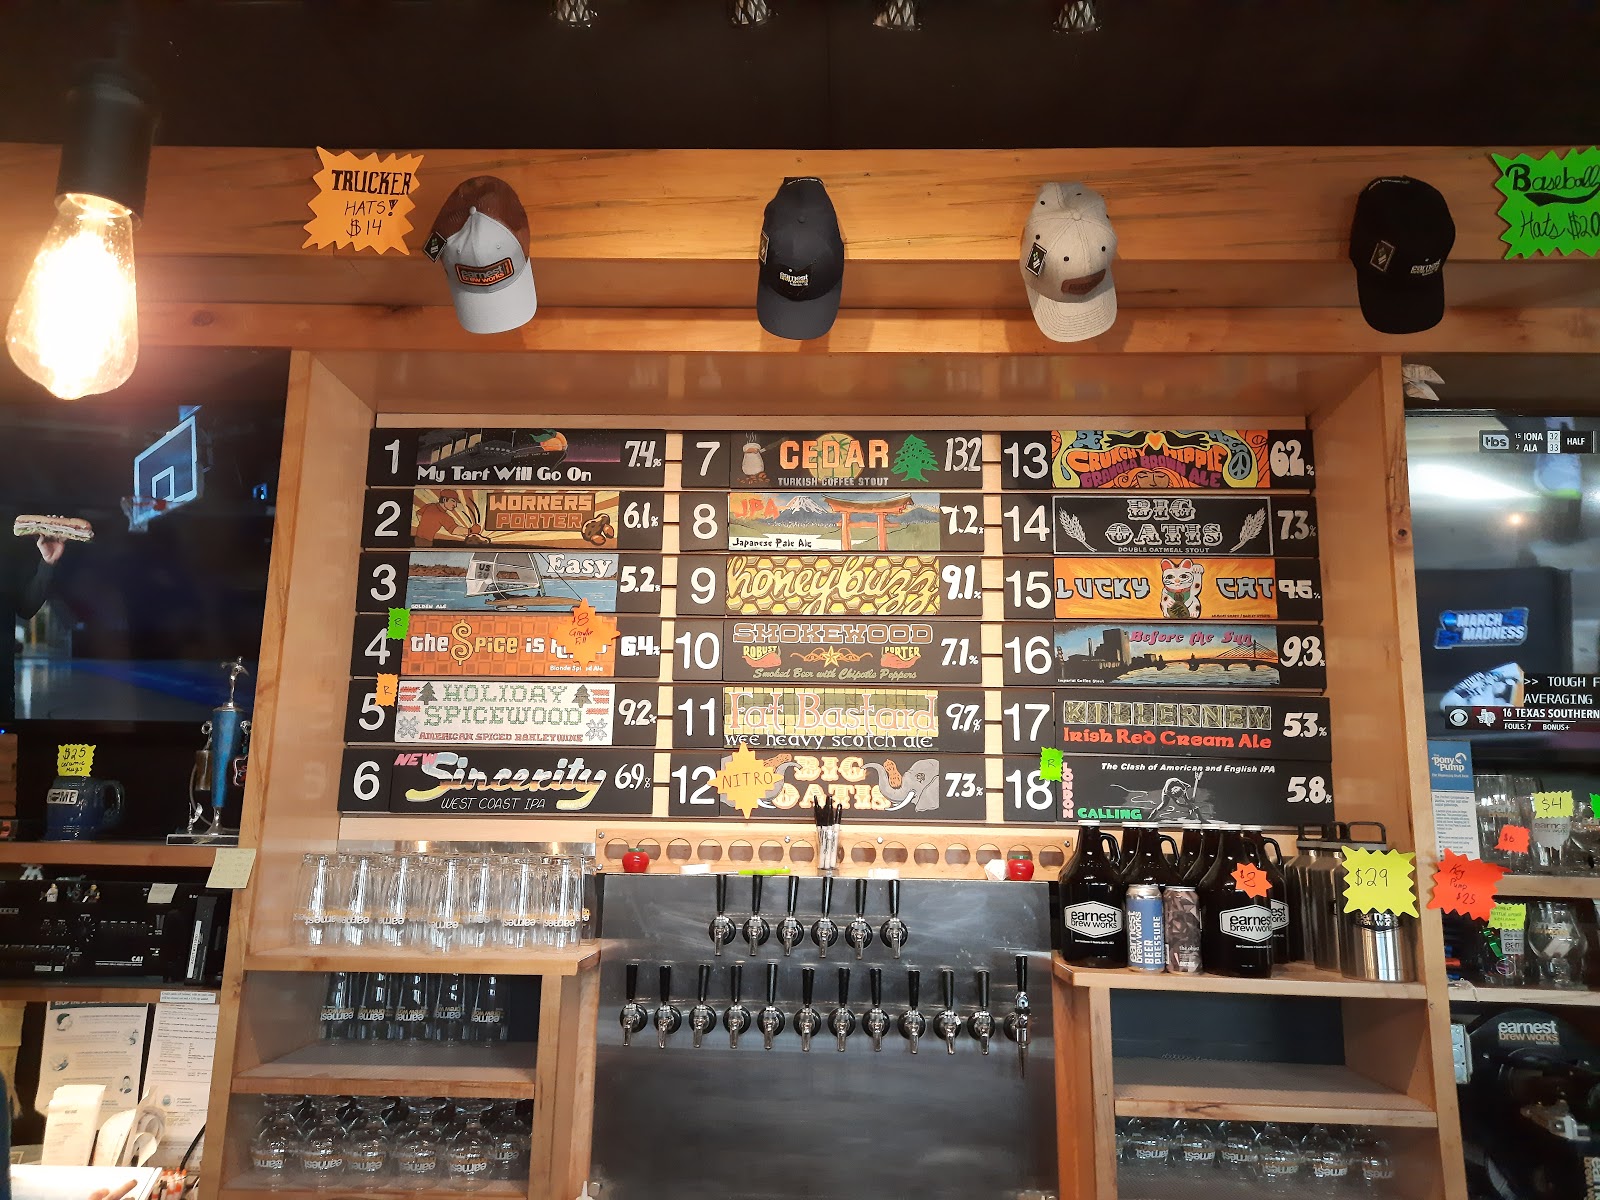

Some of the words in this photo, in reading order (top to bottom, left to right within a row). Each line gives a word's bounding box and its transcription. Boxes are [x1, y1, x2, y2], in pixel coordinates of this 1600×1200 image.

[332, 170, 412, 196] TRUCKER
[1506, 164, 1600, 191] Baseball
[344, 200, 398, 217] HATS!
[346, 219, 382, 237] $14
[1520, 211, 1566, 240] Hats
[1568, 211, 1600, 240] $20
[462, 266, 502, 278] earnest
[482, 272, 504, 282] works
[1486, 436, 1506, 448] tbs
[1524, 432, 1543, 441] IONA
[1567, 438, 1585, 446] HALF
[384, 439, 400, 474] 1
[696, 442, 721, 476] 7
[779, 440, 889, 470] CEDAR
[1004, 442, 1048, 479] 13
[1068, 443, 1148, 472] CRUNCHY
[1162, 443, 1228, 472] HIPPIE
[418, 466, 444, 482] My
[452, 466, 490, 482] Tart
[494, 466, 532, 480] Will
[537, 466, 561, 480] Go
[567, 467, 592, 482] On
[778, 478, 818, 486] TURKISH
[821, 477, 854, 486] COFFEE
[858, 477, 889, 486] STOUT
[1080, 458, 1140, 488] GRANOLA
[1140, 455, 1188, 475] BROWN
[1189, 467, 1222, 488] ALE
[490, 495, 592, 511] WORKERS
[734, 497, 781, 520] JPA
[1127, 499, 1196, 522] BIG
[374, 501, 400, 536] 2
[496, 512, 582, 529] PORTER
[692, 504, 718, 539] 8
[1003, 506, 1050, 542] 14
[732, 538, 772, 548] Japanese
[776, 538, 795, 548] Pale
[798, 538, 812, 548] Ale
[547, 554, 612, 578] Easy
[370, 564, 397, 601] 3
[690, 568, 716, 604] 9
[1005, 570, 1052, 610] 15
[1056, 577, 1151, 600] LUCKY
[1216, 577, 1274, 600] CAT
[1457, 613, 1503, 627] MARCH
[410, 634, 448, 652] the
[526, 637, 544, 653] is
[732, 622, 934, 644] SMOKEWOOD
[1130, 630, 1184, 646] Before
[1189, 630, 1214, 646] the
[1221, 632, 1253, 646] Sun
[1462, 626, 1525, 640] MADNESS
[364, 628, 390, 665] 4
[675, 632, 720, 670] 10
[743, 646, 778, 660] ROBUST
[884, 646, 921, 660] PORTER
[1004, 636, 1052, 674] 16
[753, 668, 790, 679] Smoked
[792, 668, 814, 679] Beer
[816, 668, 836, 678] with
[838, 668, 876, 680] Chipotle
[880, 668, 916, 680] Peppers
[1548, 676, 1586, 687] TOUGH
[442, 684, 568, 704] HOLIDAY
[1524, 694, 1592, 704] AVERAGING
[358, 693, 385, 730] 5
[424, 706, 582, 726] SPICEWOOD
[677, 698, 716, 736] 11
[729, 692, 784, 731] Fat
[796, 692, 937, 732] Bastard
[1064, 701, 1271, 730] KILLERNEY
[1503, 708, 1512, 717] 16
[1515, 709, 1545, 718] TEXAS
[1548, 709, 1600, 719] SOUTHERN
[1004, 703, 1050, 742] 17
[419, 732, 474, 741] AMERICAN
[475, 732, 512, 741] SPICED
[514, 732, 584, 742] BARLEYWINE
[725, 734, 761, 746] wee
[766, 734, 824, 750] heavy
[832, 734, 896, 750] scotch
[903, 736, 934, 748] ale
[1064, 728, 1112, 742] Irish
[1117, 730, 1156, 744] Red
[1160, 731, 1234, 748] Cream
[1239, 734, 1272, 749] Ale
[394, 752, 438, 766] NEW
[794, 756, 867, 782] BIG
[1120, 763, 1146, 771] Clash
[1148, 763, 1158, 771] of
[1160, 764, 1202, 773] American
[1224, 765, 1258, 774] English
[1260, 765, 1276, 774] IPA
[353, 760, 380, 800] 6
[405, 752, 606, 810] Sincerity
[671, 765, 716, 805] 12
[722, 771, 773, 789] NITRO
[1006, 769, 1053, 810] 18
[1062, 762, 1074, 819] LONDON
[441, 798, 472, 810] WEST
[479, 798, 521, 810] COAST
[524, 798, 546, 809] IPA
[1078, 808, 1142, 820] CALLING
[1541, 797, 1561, 811] $4
[1355, 868, 1388, 887] $29
[1456, 892, 1476, 904] $25
[1071, 911, 1117, 922] earnest
[1153, 916, 1161, 964] PRESSURE
[1144, 940, 1154, 964] BEER
[1498, 1020, 1557, 1034] earnest
[1526, 1033, 1559, 1042] works
